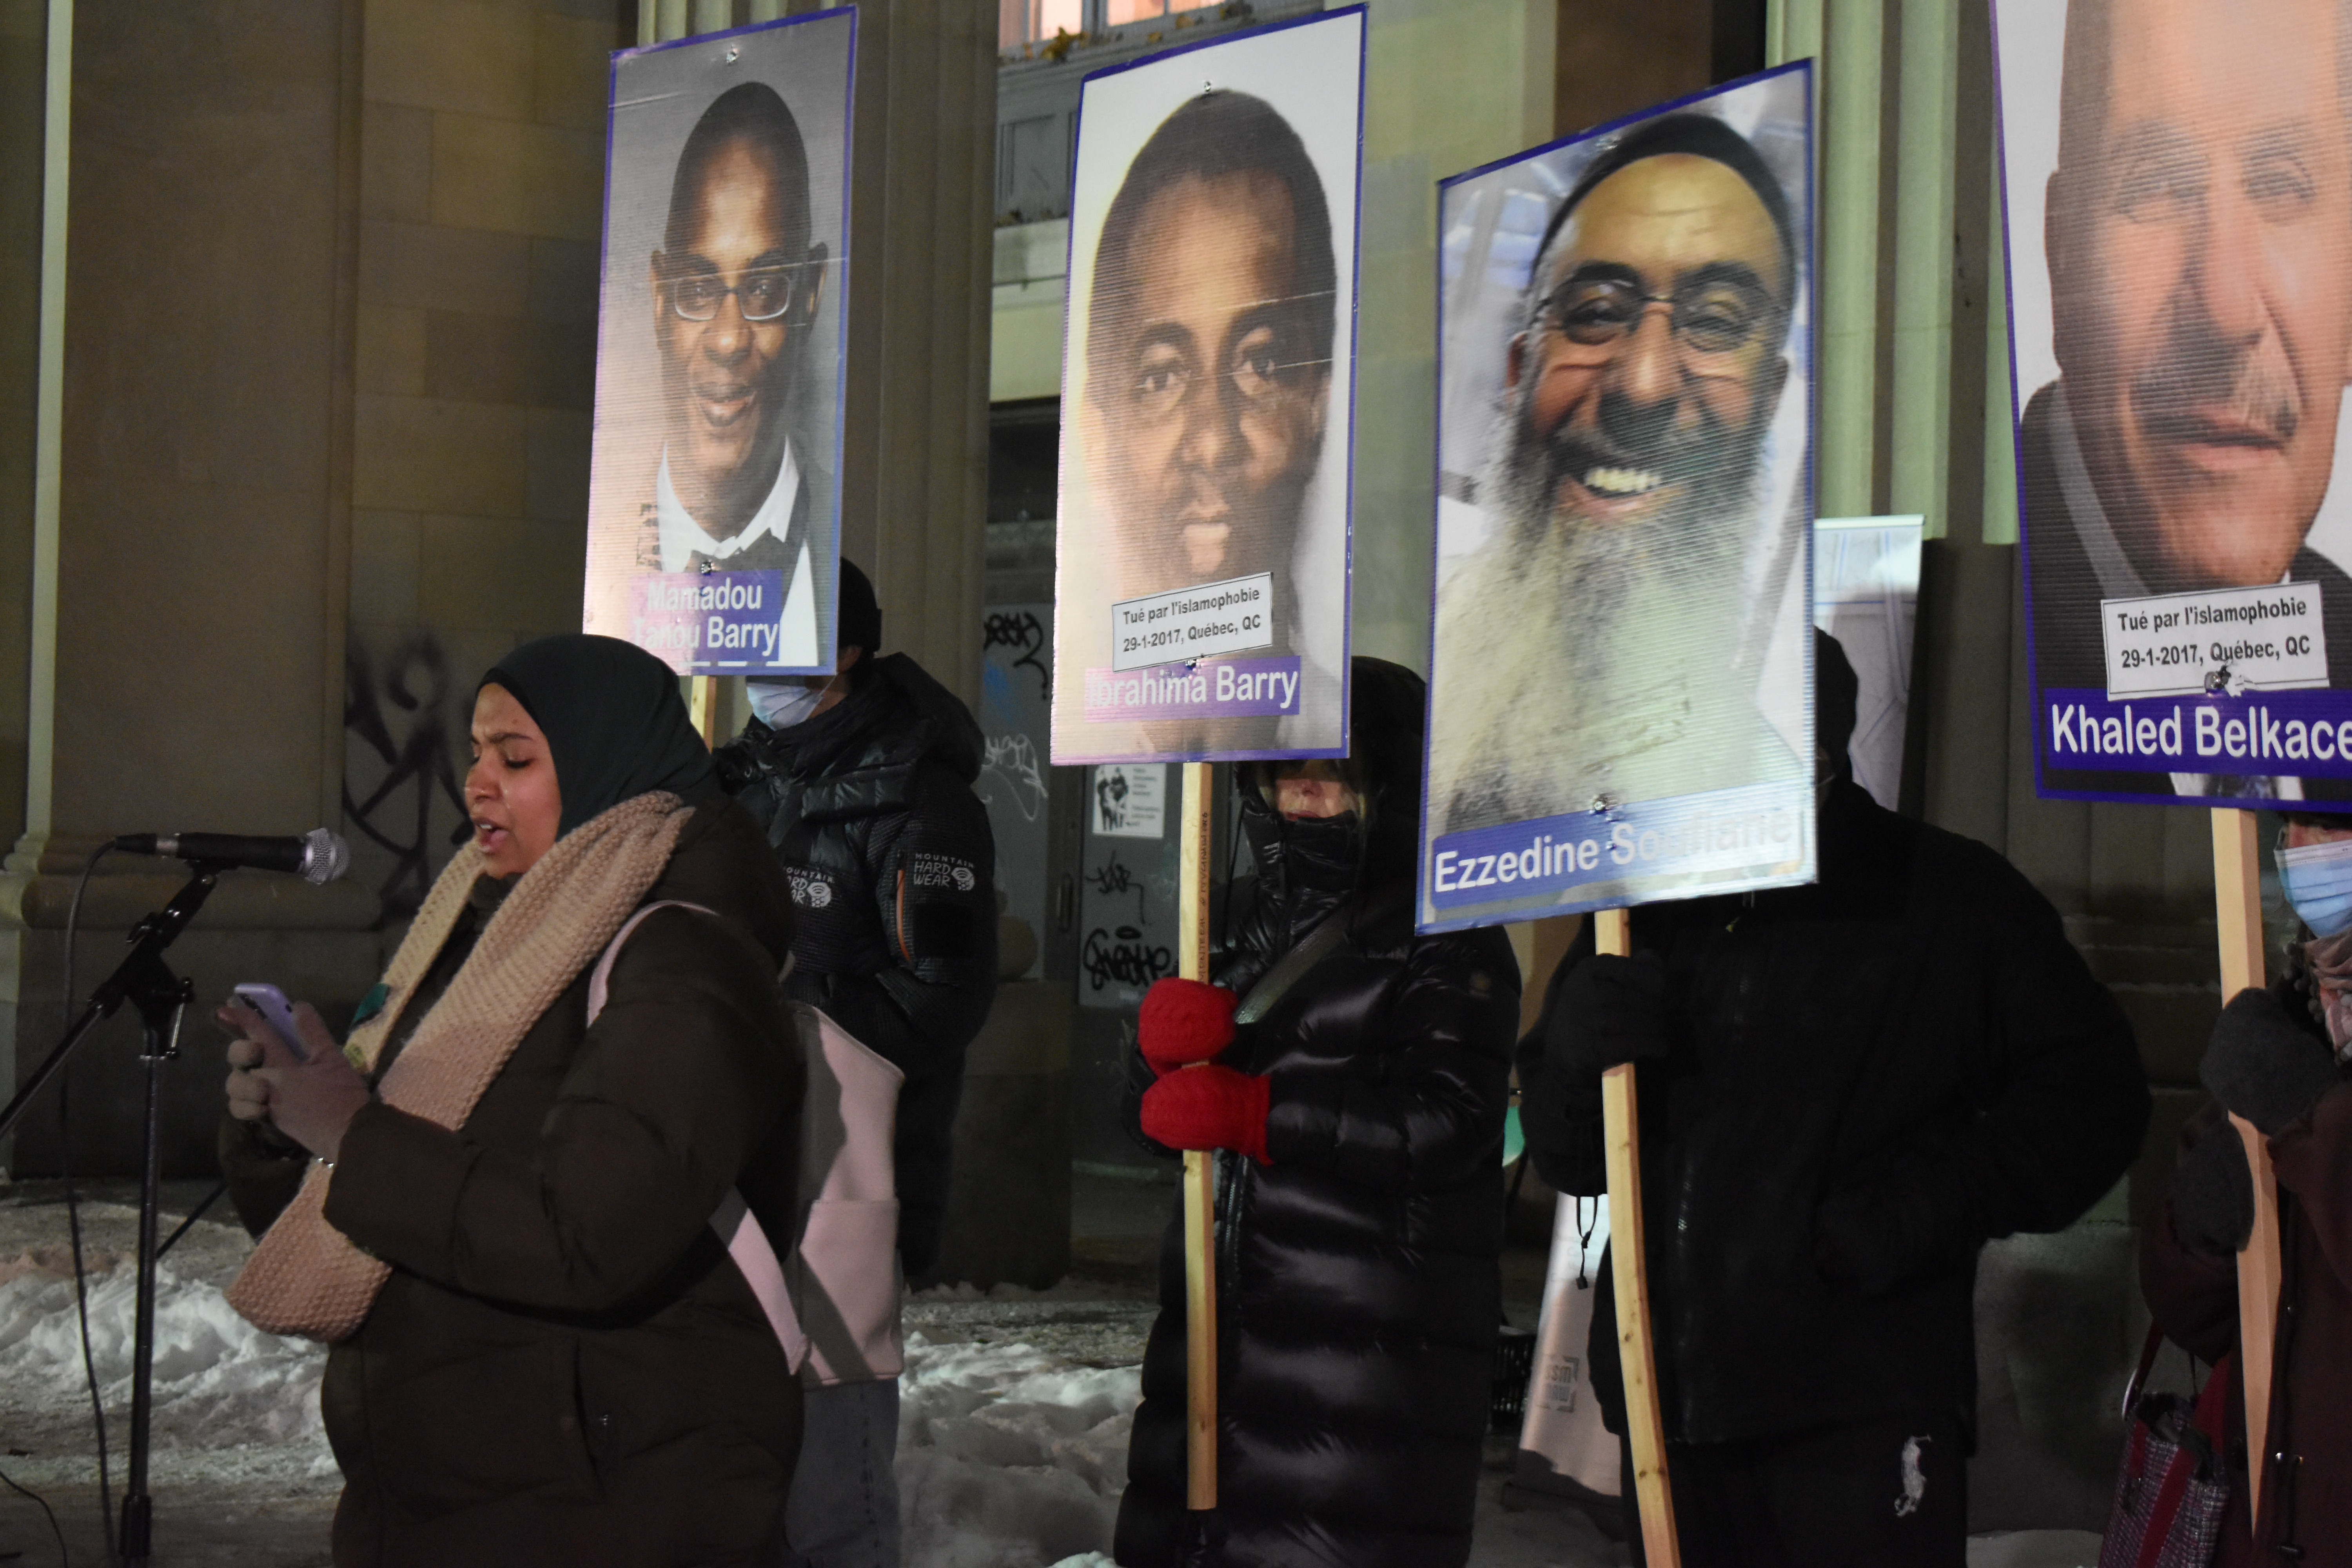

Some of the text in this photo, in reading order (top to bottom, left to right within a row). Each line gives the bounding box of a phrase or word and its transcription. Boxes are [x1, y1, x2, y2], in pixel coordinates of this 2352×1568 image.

[647, 577, 762, 610] Mamadou
[1123, 588, 1259, 624] Tué par l'islamophobie
[2118, 597, 2306, 633] Tué par l'islamophobie
[632, 617, 779, 657] Tanou Barry
[1123, 614, 1261, 652] 29-1-2017, Québec, QC
[2122, 636, 2310, 668] 29-1-2017, Québec, QC
[1088, 666, 1298, 709] Ibrahima Barry
[2052, 704, 2352, 761] Khaled Belkace
[915, 853, 975, 868] MOUNTAIN
[915, 861, 951, 875] HARD
[1435, 811, 1792, 892] Ezzedine Soufiane
[784, 866, 834, 884] OUNTAIN
[787, 875, 808, 890] ARD
[914, 874, 951, 887] WEAR
